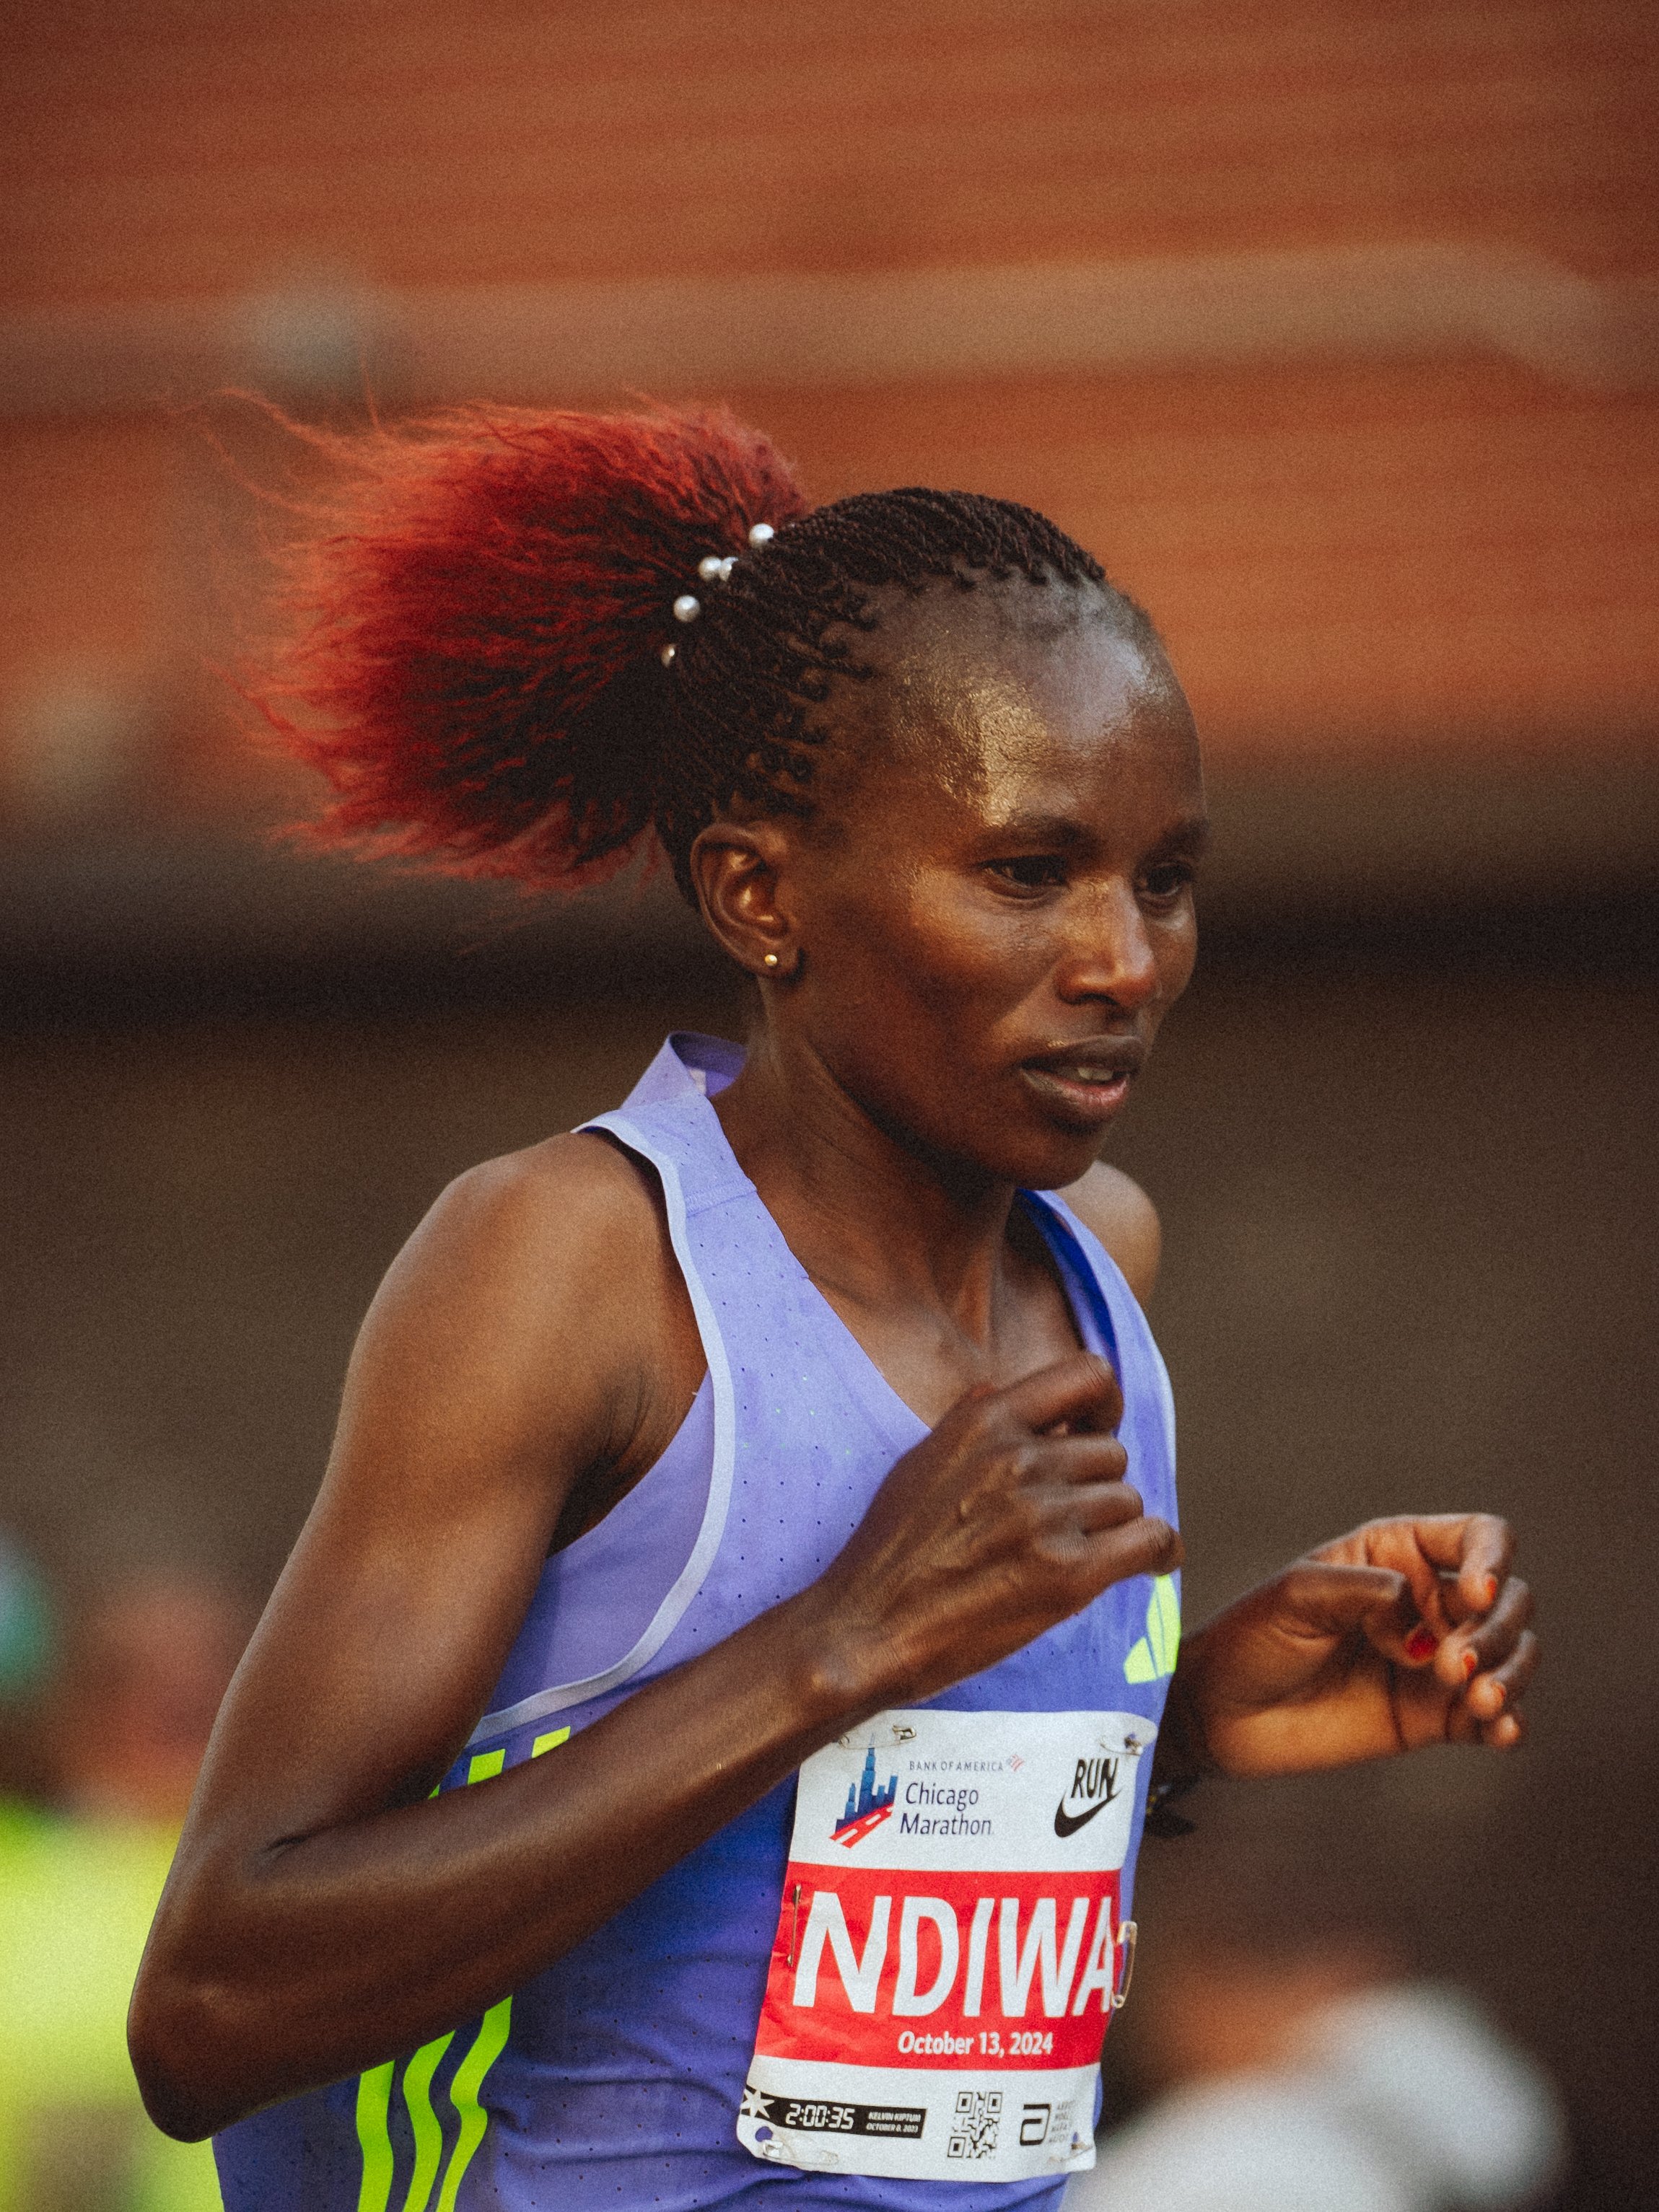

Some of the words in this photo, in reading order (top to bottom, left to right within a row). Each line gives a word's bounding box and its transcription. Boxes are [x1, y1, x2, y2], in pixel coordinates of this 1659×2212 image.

[909, 1760, 937, 1771] BANK
[940, 1760, 954, 1771] OF
[955, 1761, 1004, 1772] AMERICA
[1070, 1757, 1119, 1799] RUN
[905, 1781, 979, 1812] Chicago
[899, 1812, 992, 1835] Marathon
[792, 1891, 1115, 2018] NDIWA
[897, 2030, 974, 2055] October
[979, 2031, 1005, 2058] 13,
[1009, 2031, 1054, 2055] 2024
[786, 2103, 855, 2129] 2:00:35
[868, 2111, 894, 2120] KELVIN
